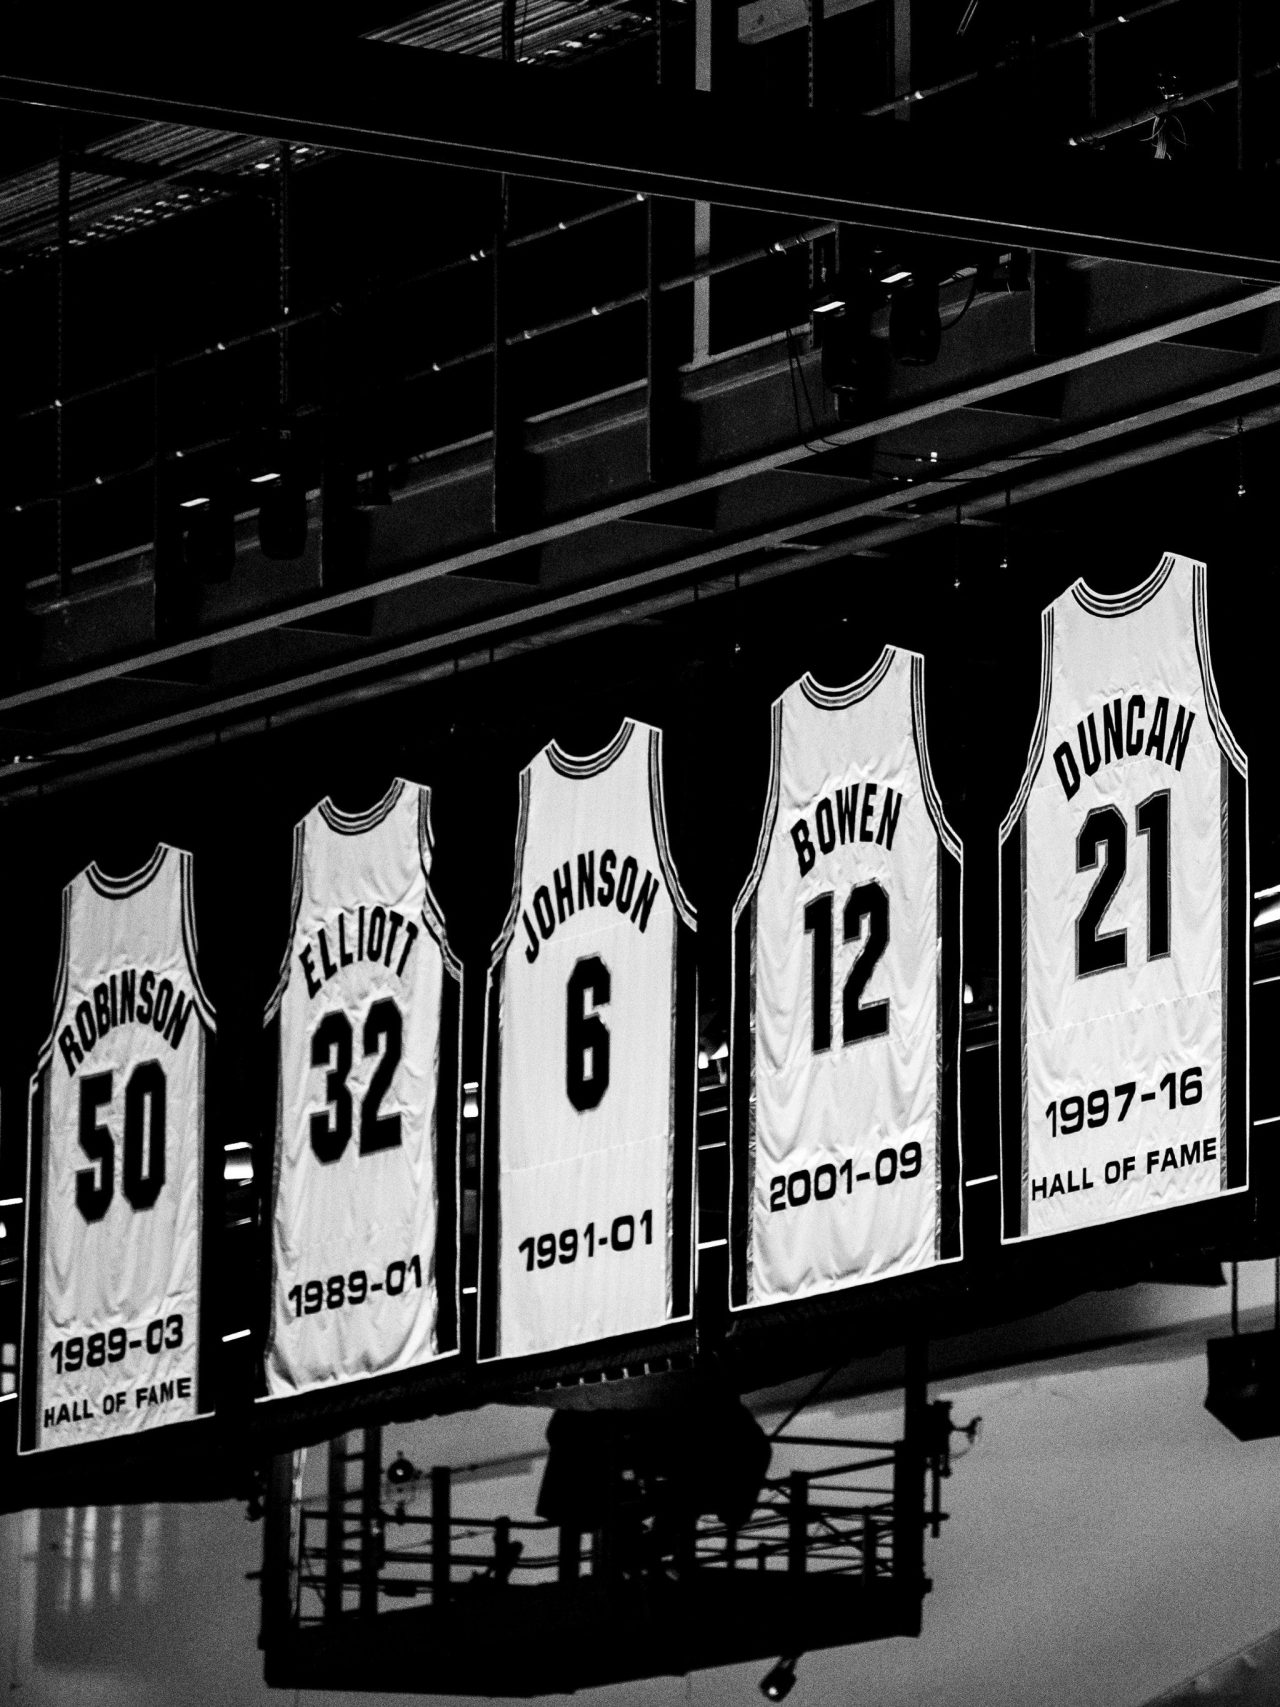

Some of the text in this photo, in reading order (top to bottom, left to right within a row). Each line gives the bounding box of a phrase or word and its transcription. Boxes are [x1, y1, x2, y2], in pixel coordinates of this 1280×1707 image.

[1053, 695, 1195, 800] DUNCAN
[790, 783, 902, 877] BOWEN
[521, 849, 659, 963] JOHNSON
[1075, 789, 1170, 979] 21
[299, 905, 418, 998] ELLIOTT
[804, 881, 890, 1054] 12
[57, 968, 189, 1075] ROBINSON
[566, 956, 611, 1113] 6
[310, 997, 403, 1165] 32
[1046, 1067, 1202, 1137] 1997-16
[75, 1059, 166, 1225] 50
[770, 1142, 921, 1212] 2001-09
[1032, 1138, 1216, 1200] HALL OF FAME
[288, 1255, 421, 1317] 1989-01
[519, 1210, 652, 1271] 1991-01
[51, 1314, 183, 1374] 1989-03
[44, 1378, 191, 1428] HALL OF FAME
